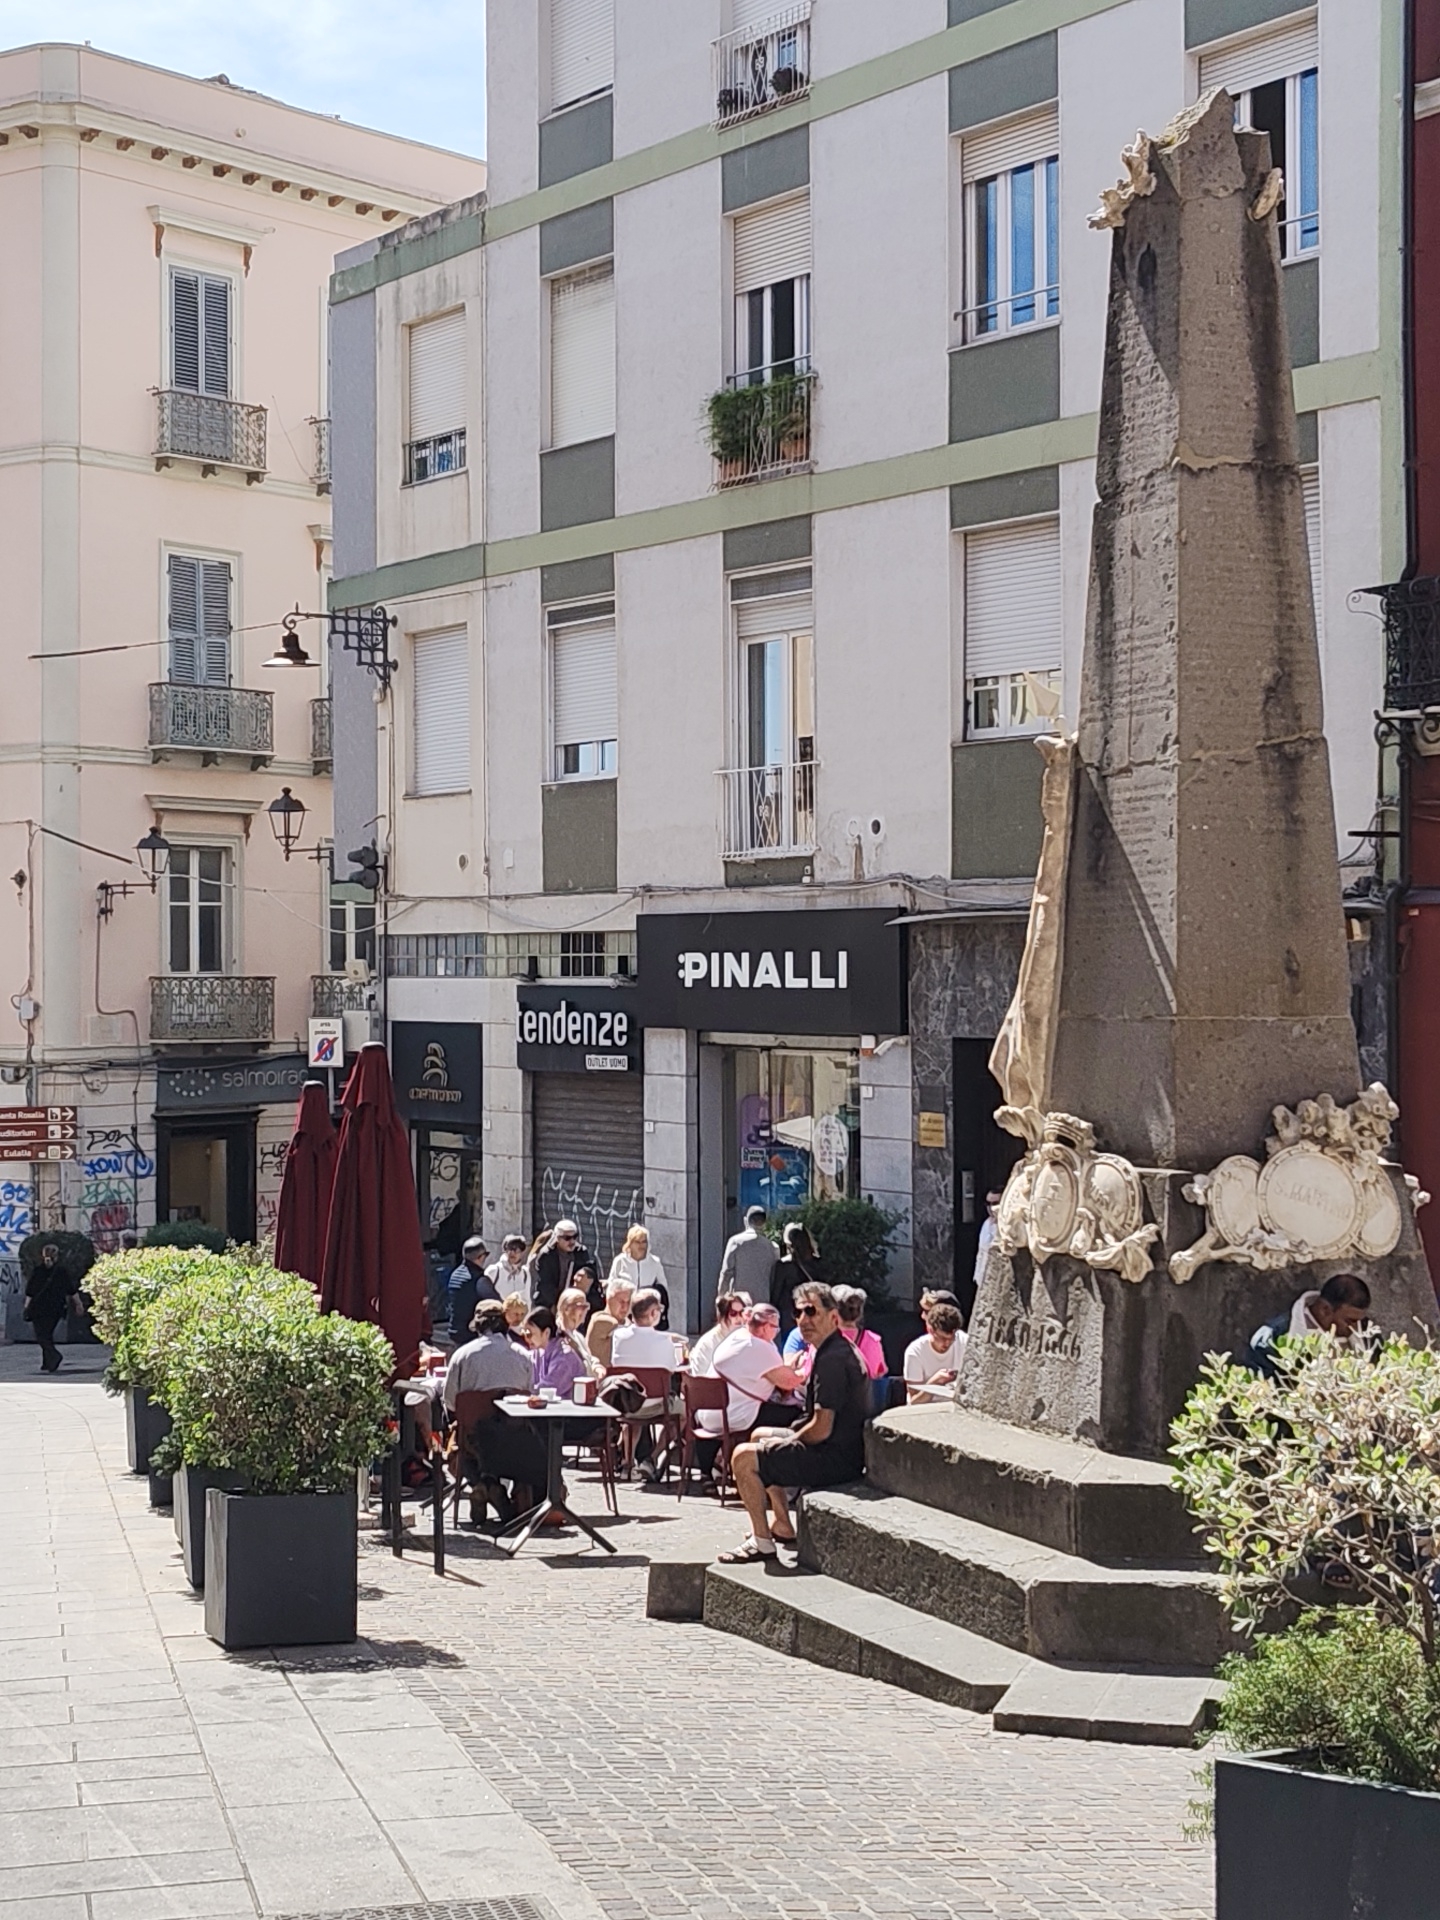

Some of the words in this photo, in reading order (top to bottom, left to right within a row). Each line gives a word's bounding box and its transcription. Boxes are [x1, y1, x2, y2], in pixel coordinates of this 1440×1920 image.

[516, 1000, 628, 1046] tendenze
[588, 1057, 608, 1067] OUTLET
[609, 1058, 626, 1067] UOMO
